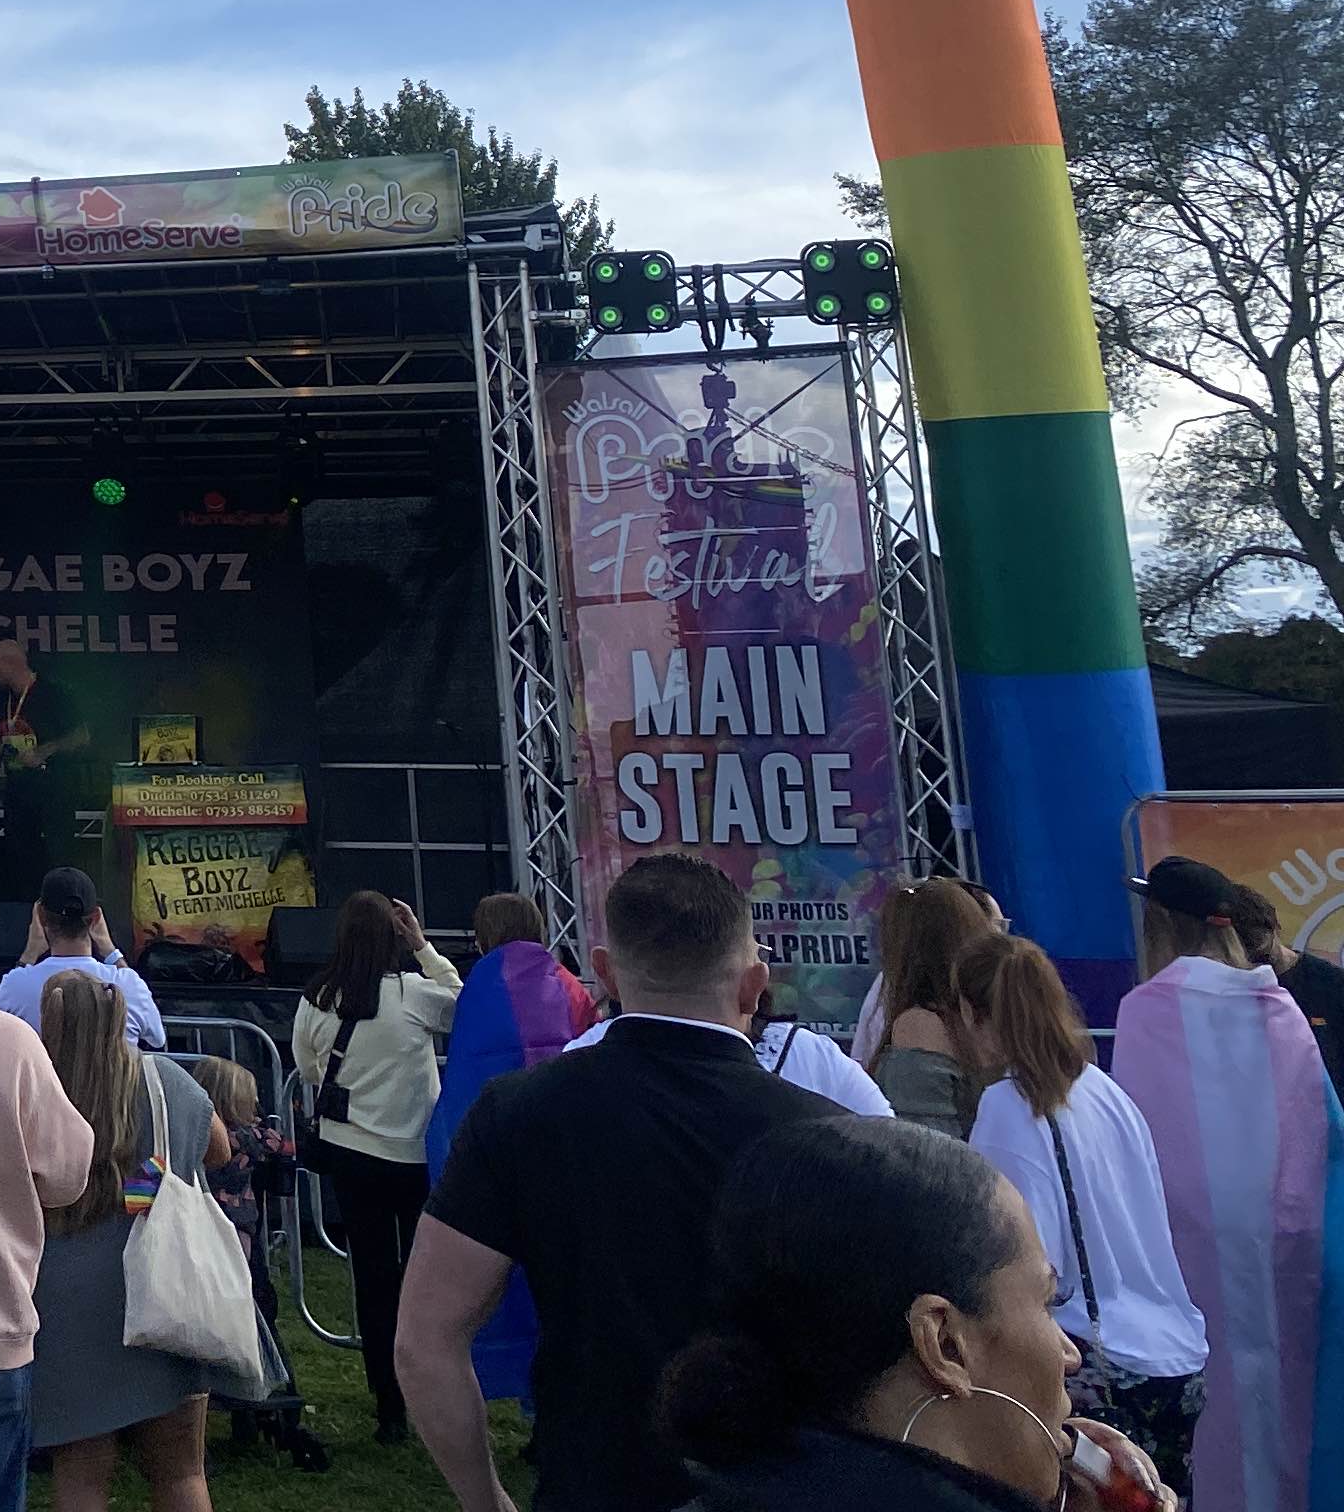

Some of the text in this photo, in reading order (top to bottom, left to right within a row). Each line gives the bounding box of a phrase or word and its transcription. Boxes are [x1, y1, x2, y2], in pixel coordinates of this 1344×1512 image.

[287, 181, 439, 239] Pride
[34, 217, 242, 257] HomeServe
[562, 392, 650, 426] Walsall
[102, 553, 252, 591] BOYZ
[589, 502, 844, 610] Festival
[632, 645, 826, 737] MAIN
[152, 773, 264, 788] For Bookings Call
[619, 751, 859, 845] STAGE
[126, 808, 141, 817] or
[143, 806, 202, 818] Michelle:
[206, 806, 244, 817] 07935
[145, 835, 262, 866] REGGAE
[181, 866, 252, 896] BOYZ
[752, 902, 849, 921] UR PHOTOS
